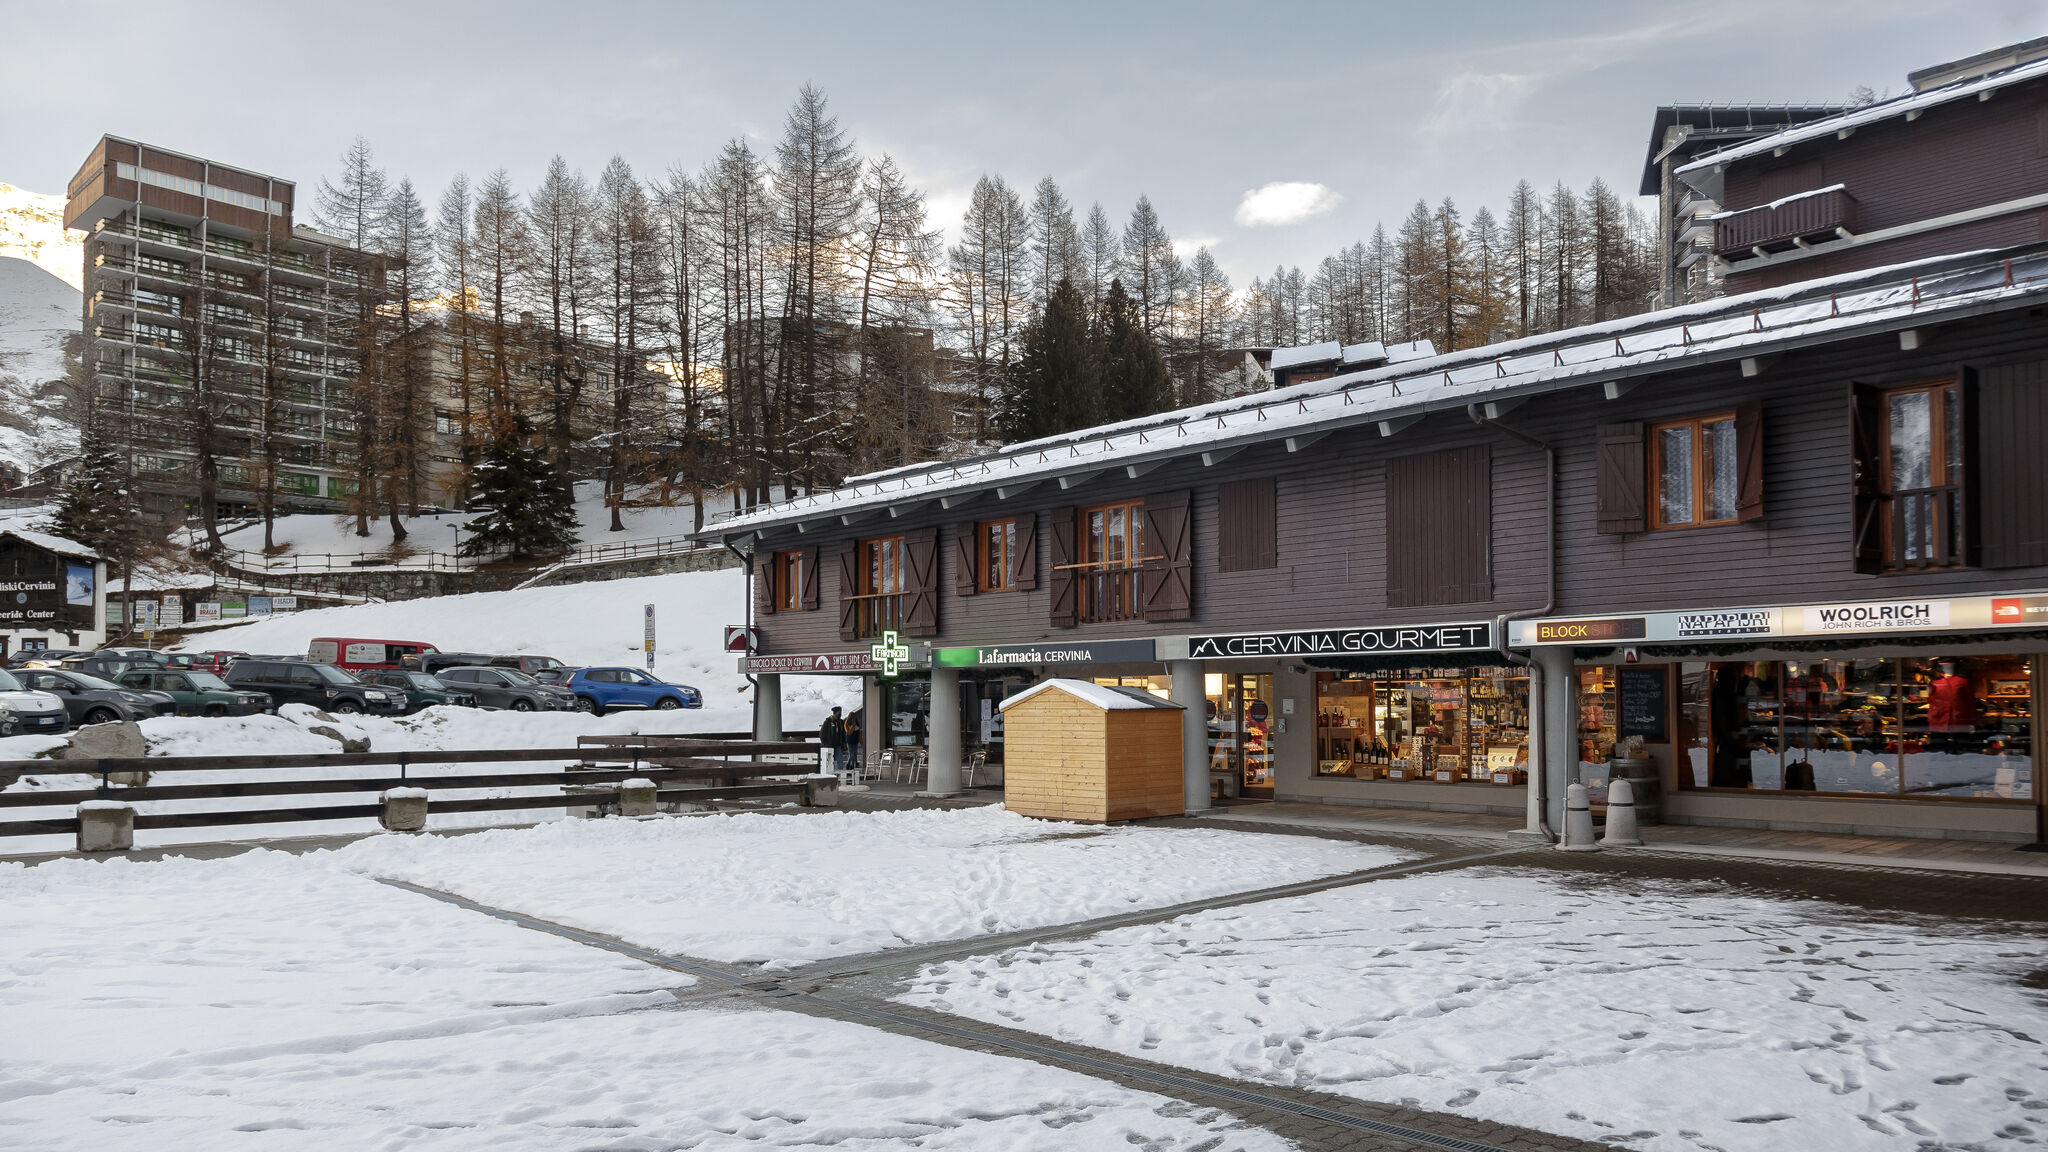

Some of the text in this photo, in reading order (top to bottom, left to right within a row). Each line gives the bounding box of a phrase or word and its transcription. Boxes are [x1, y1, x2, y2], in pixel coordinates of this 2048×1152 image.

[27, 609, 55, 619] Center
[1820, 604, 1929, 622] WOOLRICH
[1680, 612, 1769, 629] NAPAPIJRI
[1822, 621, 1852, 630] JOHN
[1855, 619, 1881, 628] RICH
[1885, 619, 1893, 627] &
[1541, 623, 1640, 639] BLOCK STORE
[1227, 627, 1482, 654] CERVINIA GOURMET
[833, 655, 847, 665] SWEET
[849, 655, 860, 664] SIDE
[876, 649, 905, 658] FARMACIA
